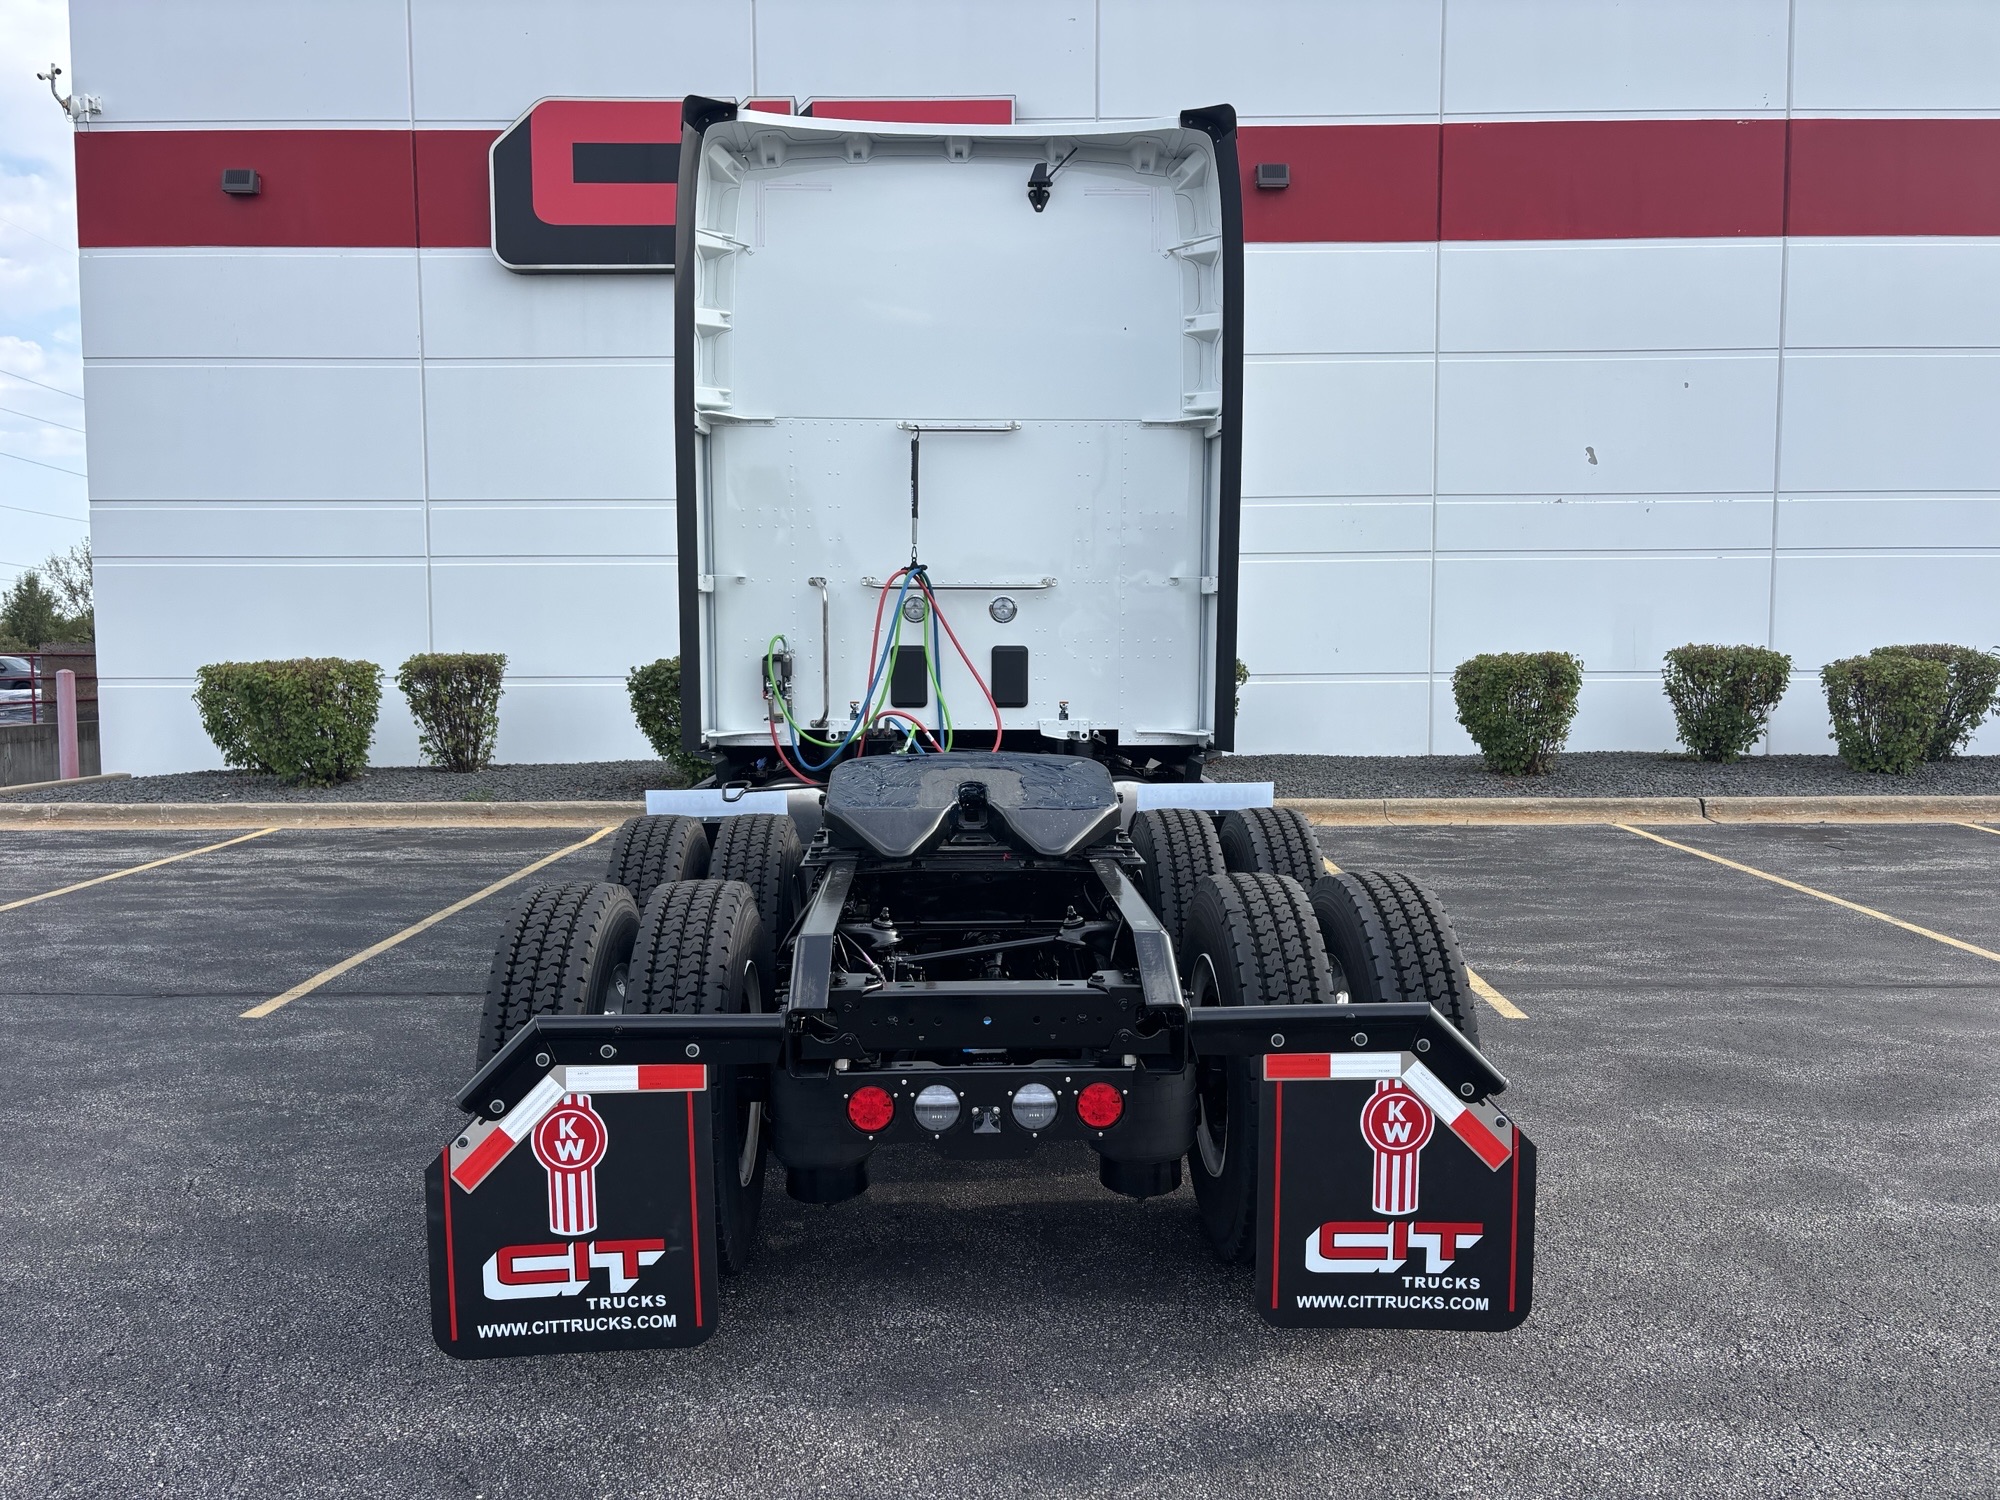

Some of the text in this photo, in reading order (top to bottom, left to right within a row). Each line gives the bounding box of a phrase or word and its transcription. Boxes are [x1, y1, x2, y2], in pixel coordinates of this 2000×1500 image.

[1305, 1220, 1484, 1274] CIT
[482, 1238, 666, 1300] CIT
[1401, 1276, 1481, 1289] TRUCKS
[586, 1294, 667, 1310] TRUCKS
[1296, 1295, 1490, 1311] WWW.CITTRUCKS.COM
[477, 1314, 677, 1339] WWW.CITTRUCKS.COM
